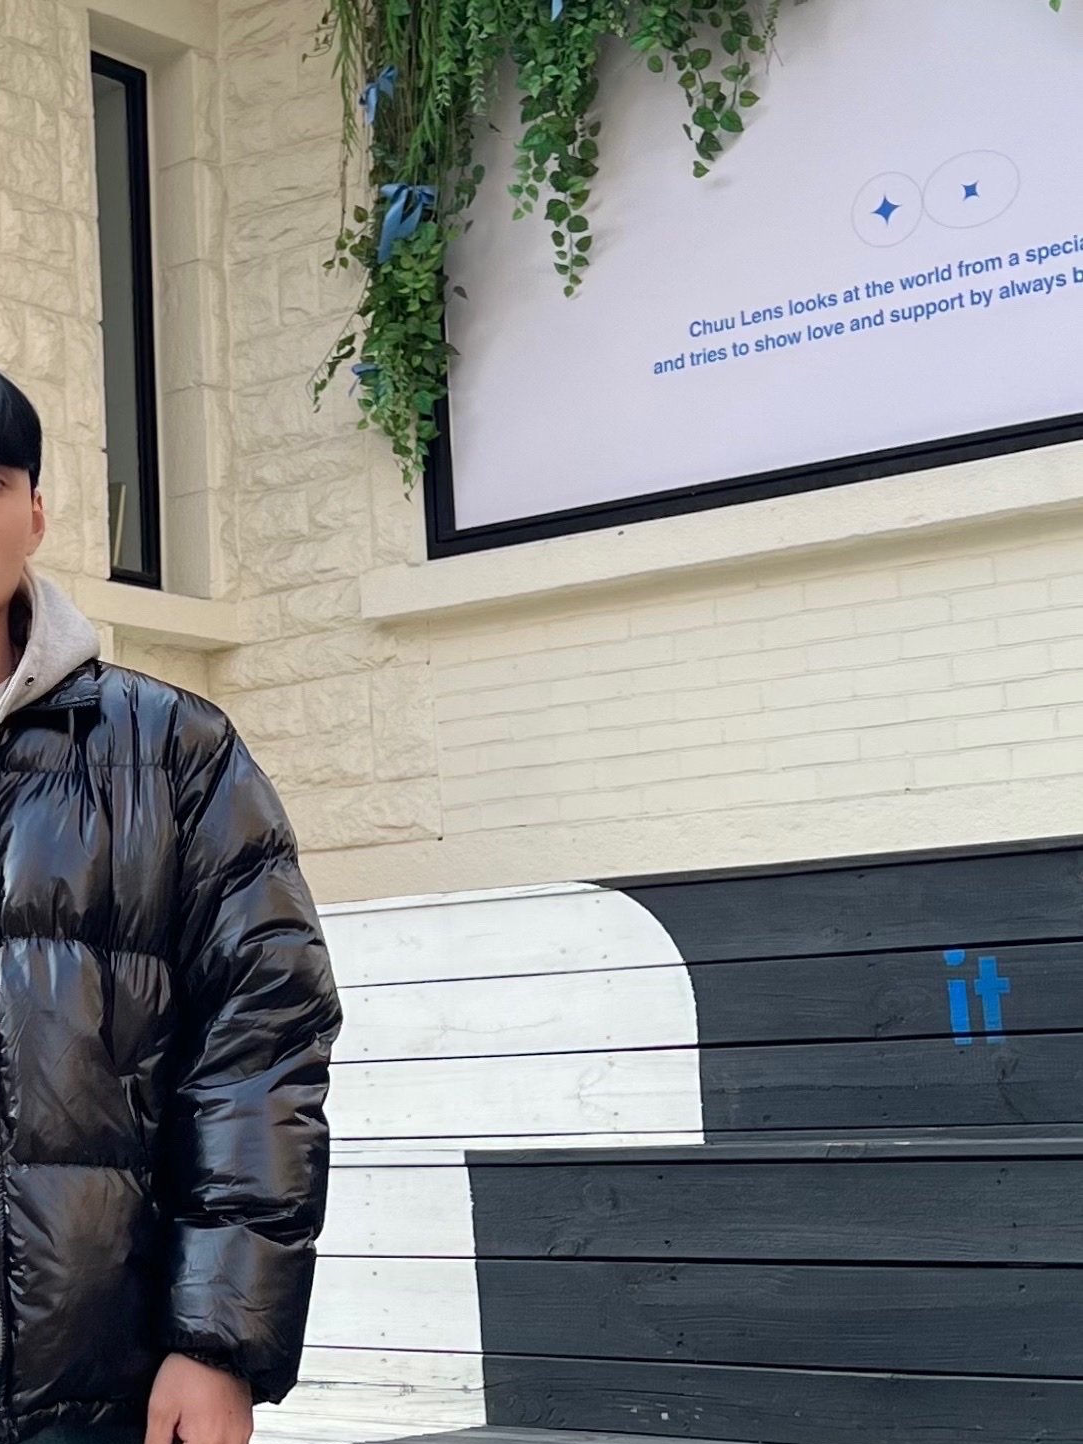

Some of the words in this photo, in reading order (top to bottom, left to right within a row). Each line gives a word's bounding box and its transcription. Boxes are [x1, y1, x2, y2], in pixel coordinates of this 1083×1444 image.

[653, 353, 685, 375] and
[690, 347, 728, 367] tries
[732, 342, 750, 357] to
[754, 330, 802, 352] show
[807, 321, 845, 341] love
[849, 309, 884, 332] and
[890, 292, 965, 322] support
[970, 288, 993, 308] by
[999, 272, 1067, 300] always
[689, 316, 735, 337] Chuu
[740, 305, 784, 327] Lens
[788, 293, 838, 316] looks
[843, 285, 861, 303] at
[865, 280, 895, 299] the
[900, 264, 952, 290] world
[958, 256, 1002, 278] from
[1008, 252, 1020, 267] a
[943, 949, 1010, 1045] it
